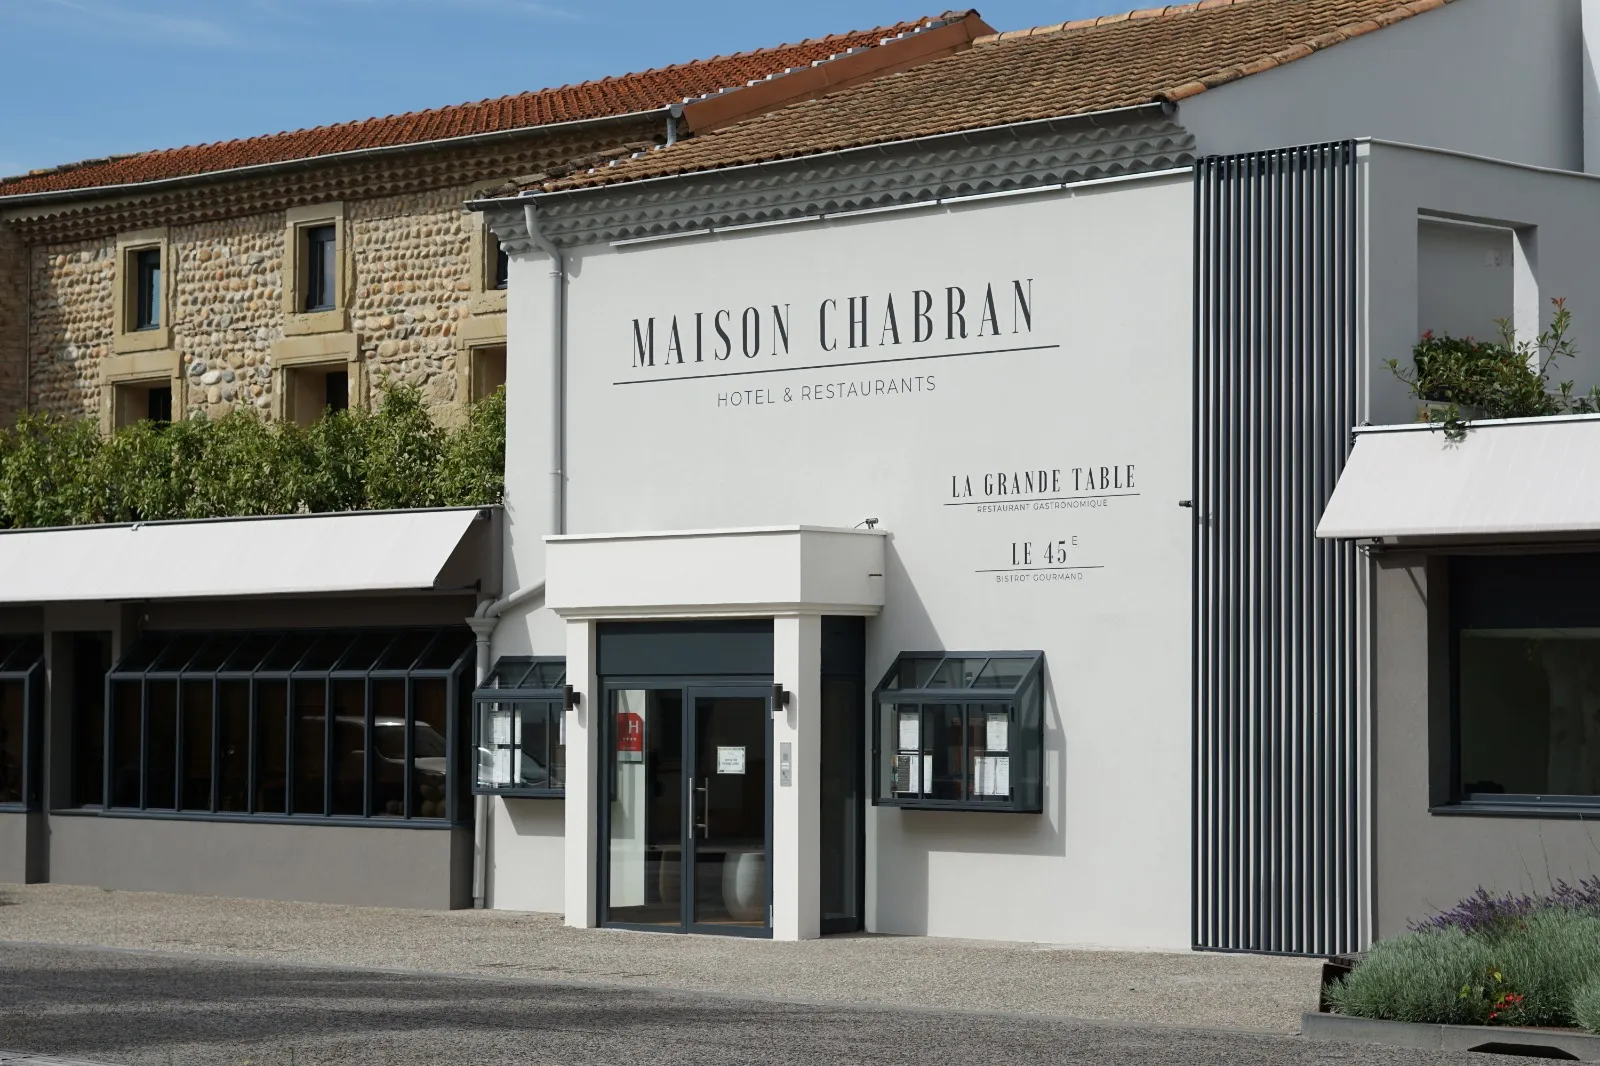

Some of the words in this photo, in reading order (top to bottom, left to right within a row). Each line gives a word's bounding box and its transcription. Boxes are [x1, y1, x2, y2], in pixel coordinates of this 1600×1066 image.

[631, 303, 791, 368] MAISON
[819, 278, 1035, 352] CHABRAN
[717, 389, 775, 407] HOTEL
[783, 387, 793, 402] &
[801, 375, 936, 401] RESTAURANTS
[952, 474, 973, 498] LA
[984, 469, 1061, 496] GRANDE
[1071, 464, 1136, 491] TABLE
[977, 503, 1030, 513] RESTAURANT
[1032, 499, 1108, 510] GASTRONOMIQUE
[1011, 541, 1032, 566] LE
[996, 574, 1030, 583] BISTROT
[1033, 572, 1083, 581] GOURMAND
[628, 720, 639, 734] H
